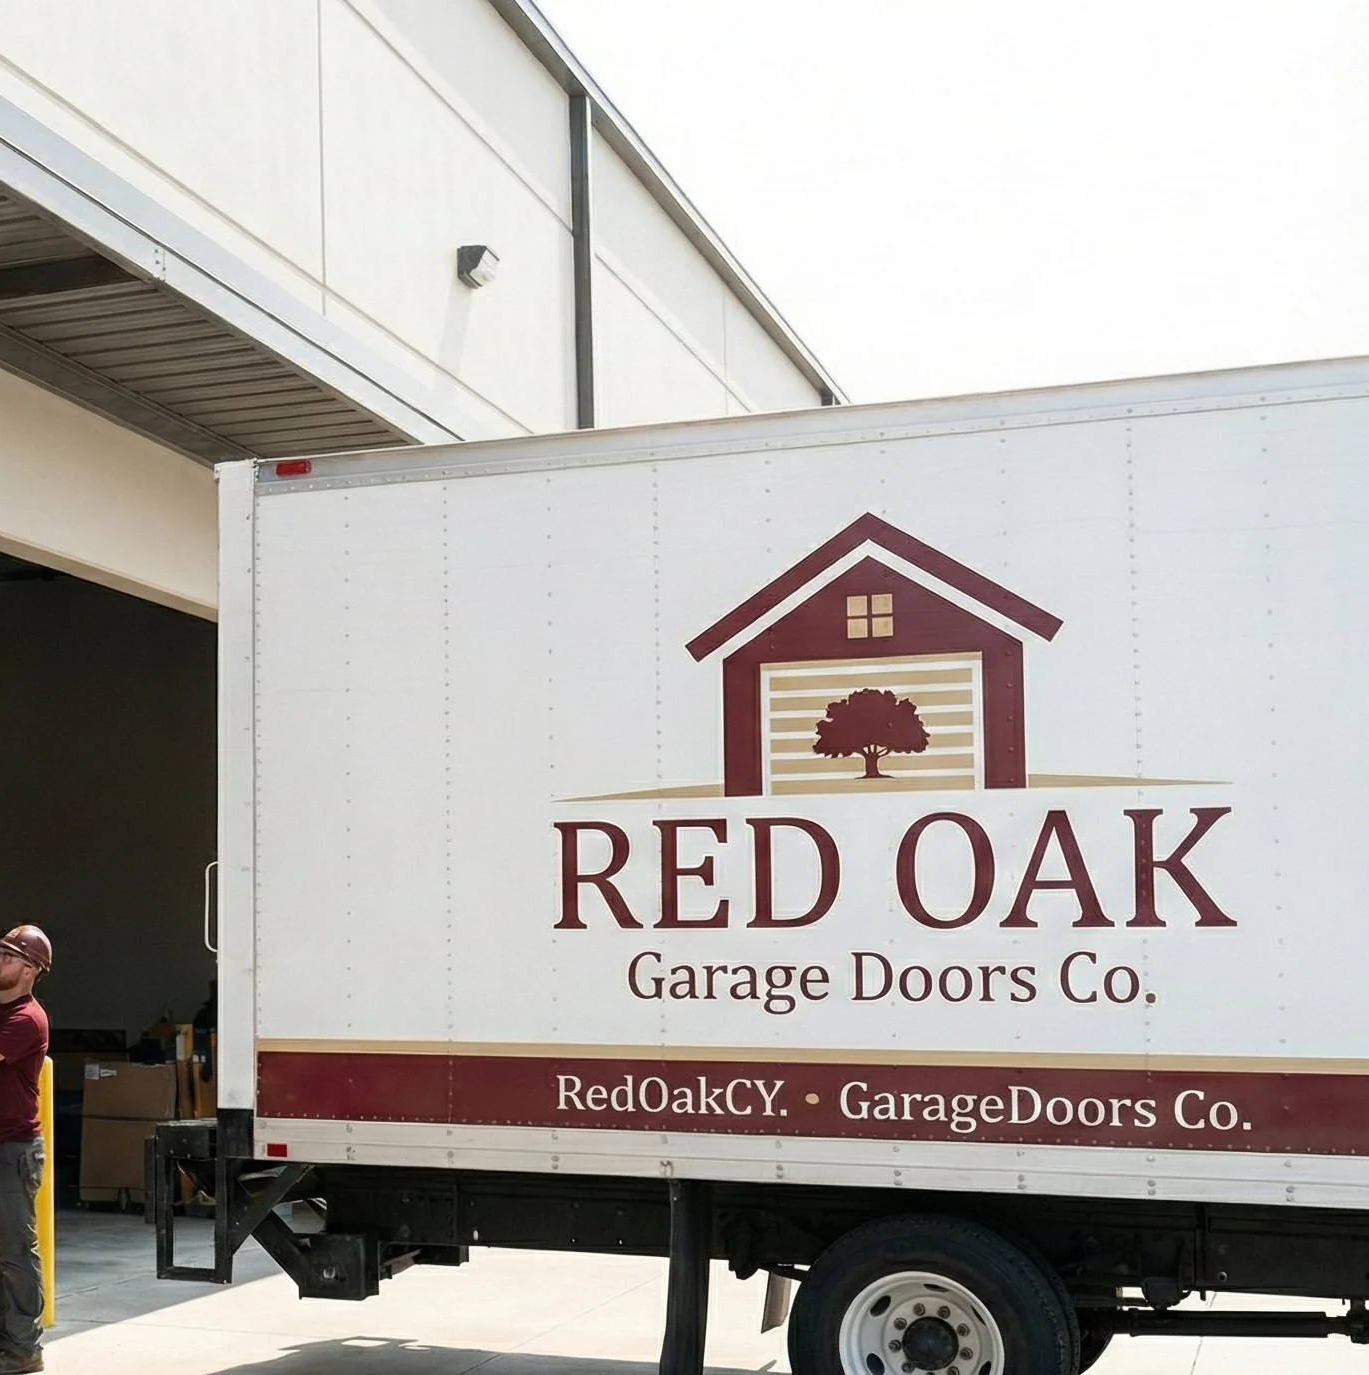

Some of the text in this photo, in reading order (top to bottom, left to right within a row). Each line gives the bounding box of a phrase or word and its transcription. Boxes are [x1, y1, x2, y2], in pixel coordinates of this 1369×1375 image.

[553, 806, 1238, 930] RED OAK
[628, 951, 1157, 1015] Garage Doors Co.
[555, 1074, 1254, 1133] RedOakCY. GarageDoors Co.
